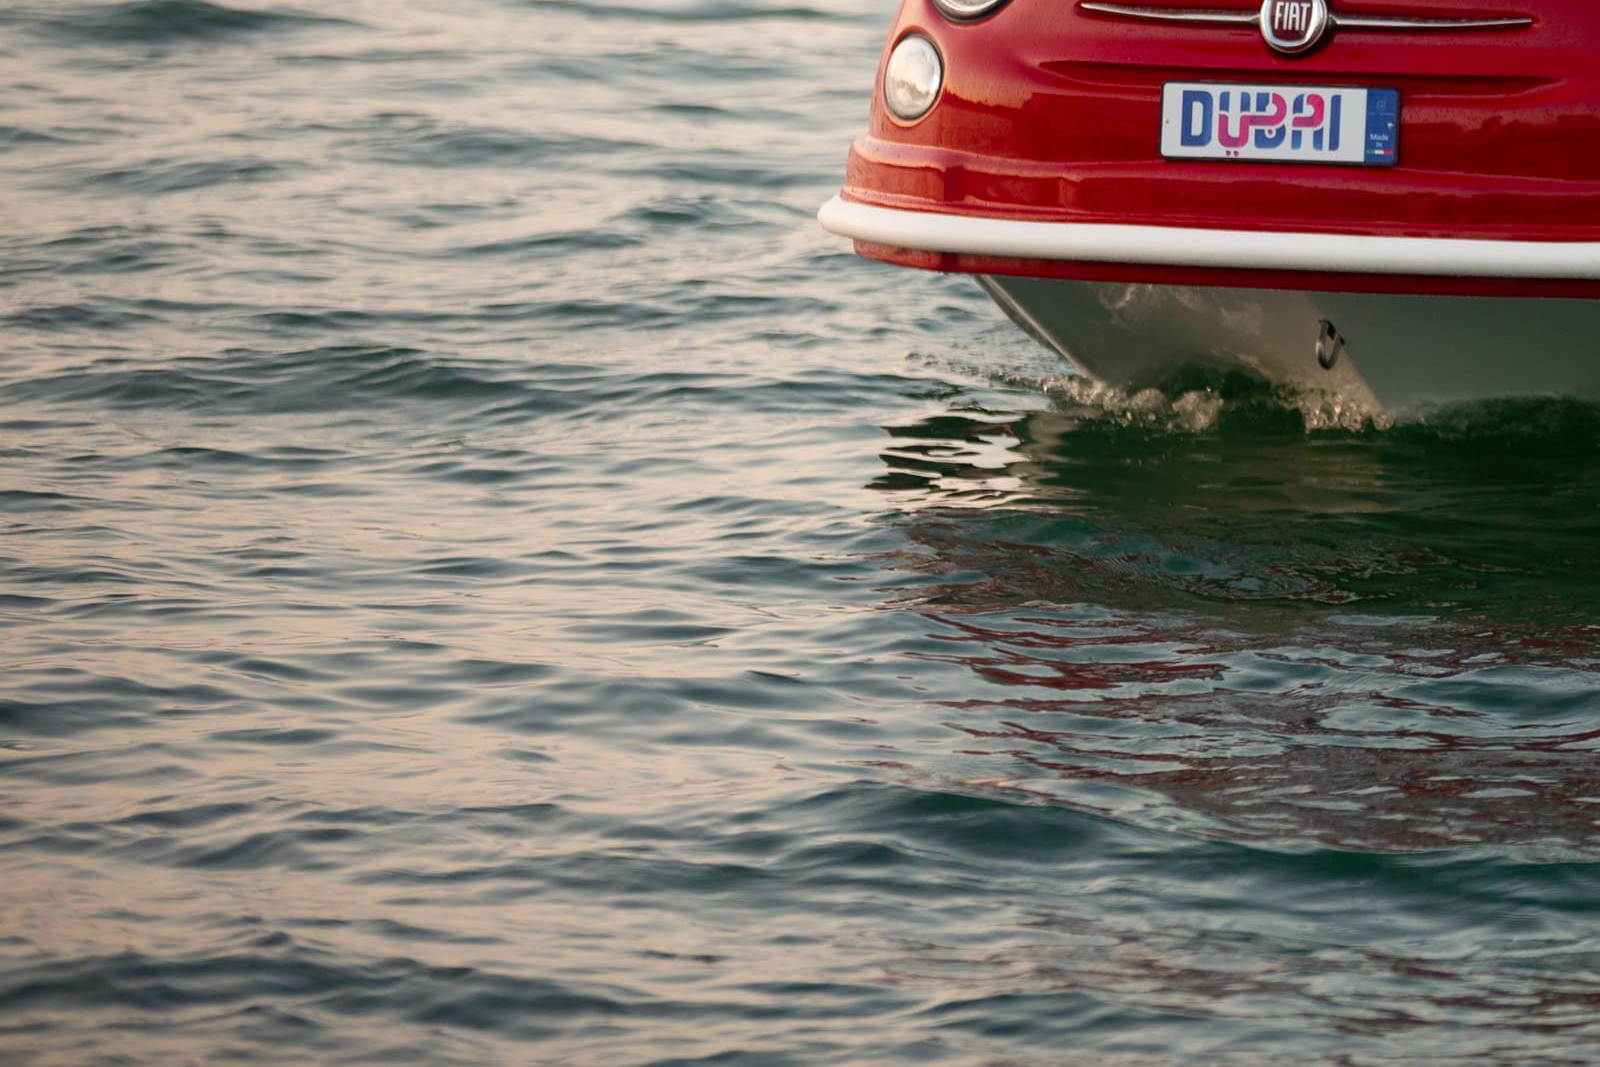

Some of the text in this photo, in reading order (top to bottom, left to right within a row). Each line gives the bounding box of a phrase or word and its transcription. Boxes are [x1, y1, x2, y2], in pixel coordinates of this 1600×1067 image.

[1274, 1, 1311, 31] FIAT
[1180, 90, 1342, 151] DUBAI
[1369, 133, 1389, 142] Made
